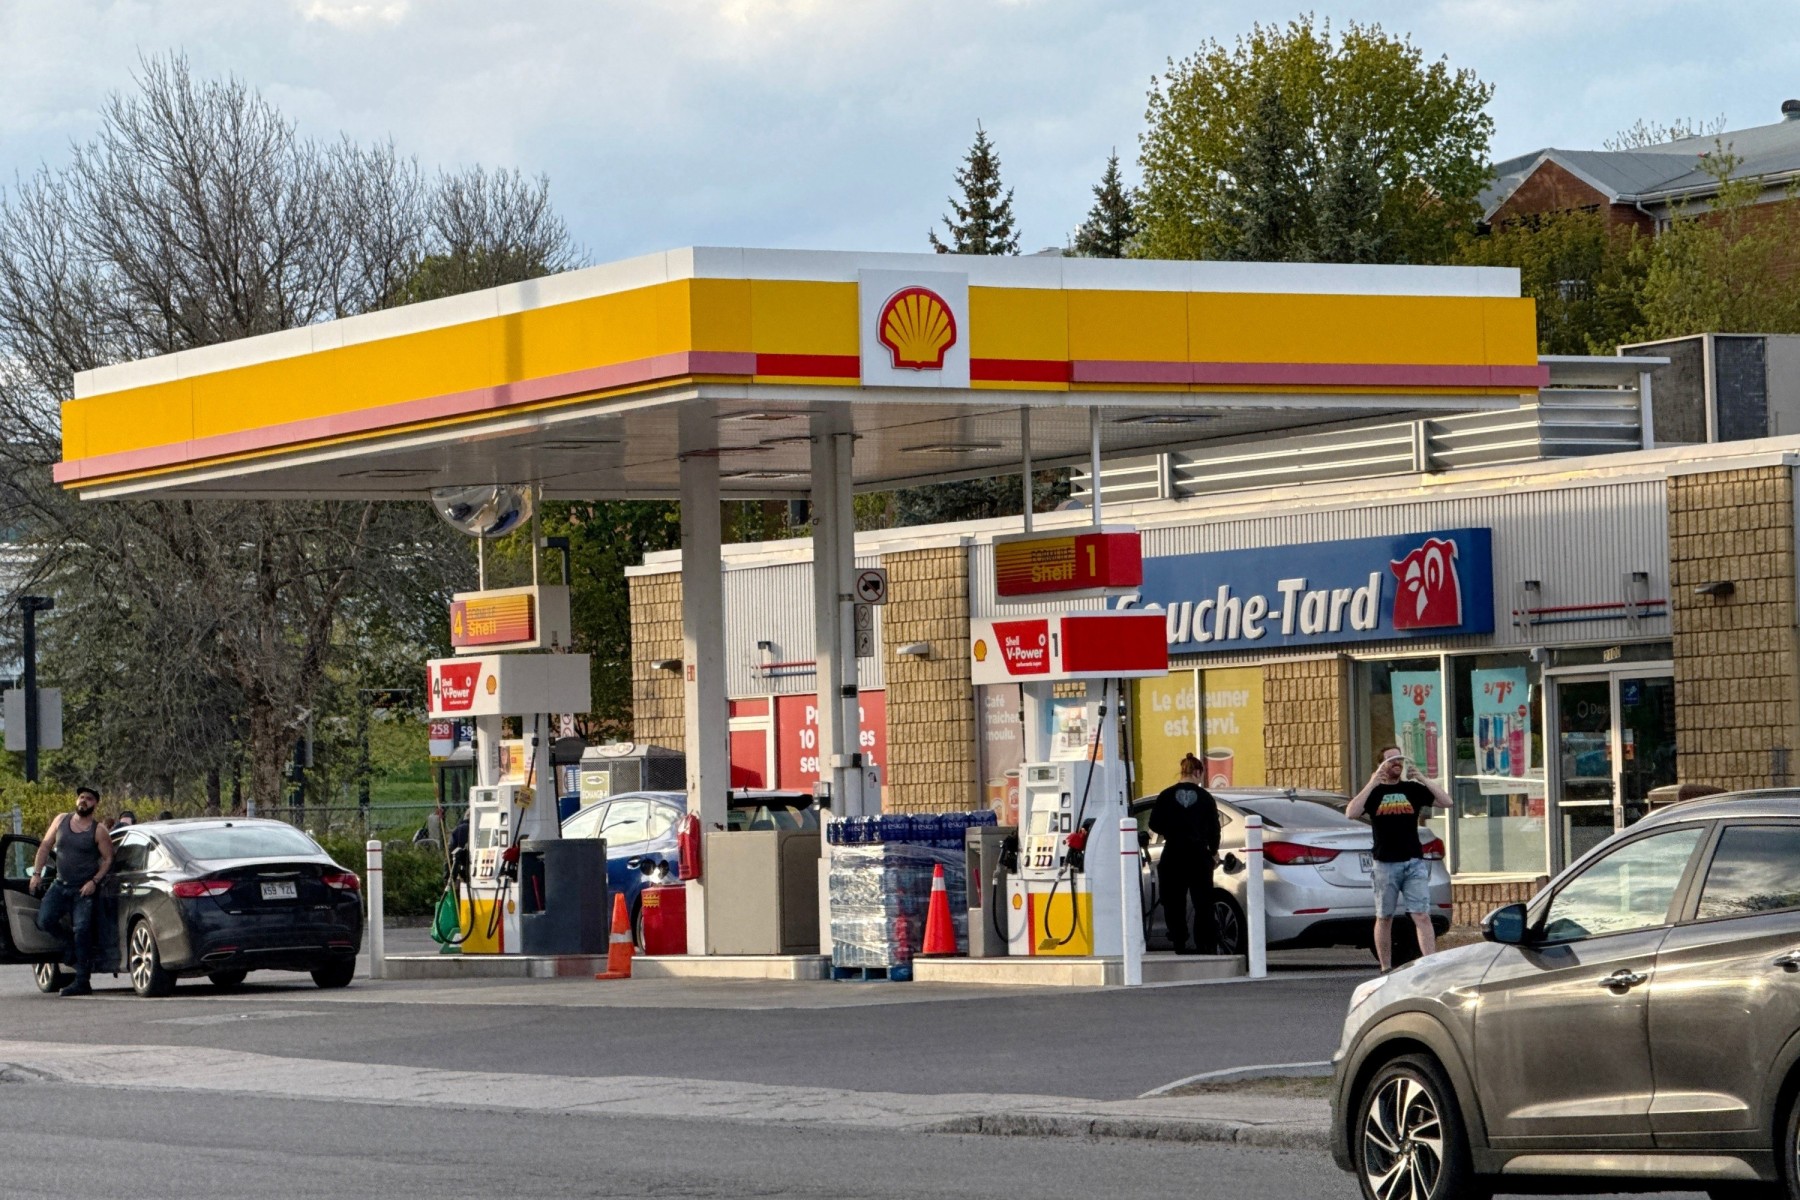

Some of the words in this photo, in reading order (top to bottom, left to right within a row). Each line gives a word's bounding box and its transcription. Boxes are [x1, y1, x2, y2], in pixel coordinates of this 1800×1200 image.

[1086, 545, 1096, 576] 1
[1032, 563, 1072, 582] Shell
[1115, 571, 1382, 644] uche-Tard
[454, 611, 463, 638] 4
[468, 620, 497, 636] Shell
[1005, 635, 1020, 647] Shell
[1052, 633, 1058, 657] 1
[1006, 647, 1043, 660] V-Power
[433, 678, 441, 698] 4
[442, 678, 453, 687] Shell
[442, 687, 470, 699] V-Power
[1152, 690, 1171, 712] Le
[1175, 687, 1249, 710] déeuner
[431, 724, 450, 735] 258
[1164, 716, 1188, 737] est
[799, 729, 815, 749] 10
[1382, 793, 1408, 804] STAR
[1376, 802, 1414, 816] WARS
